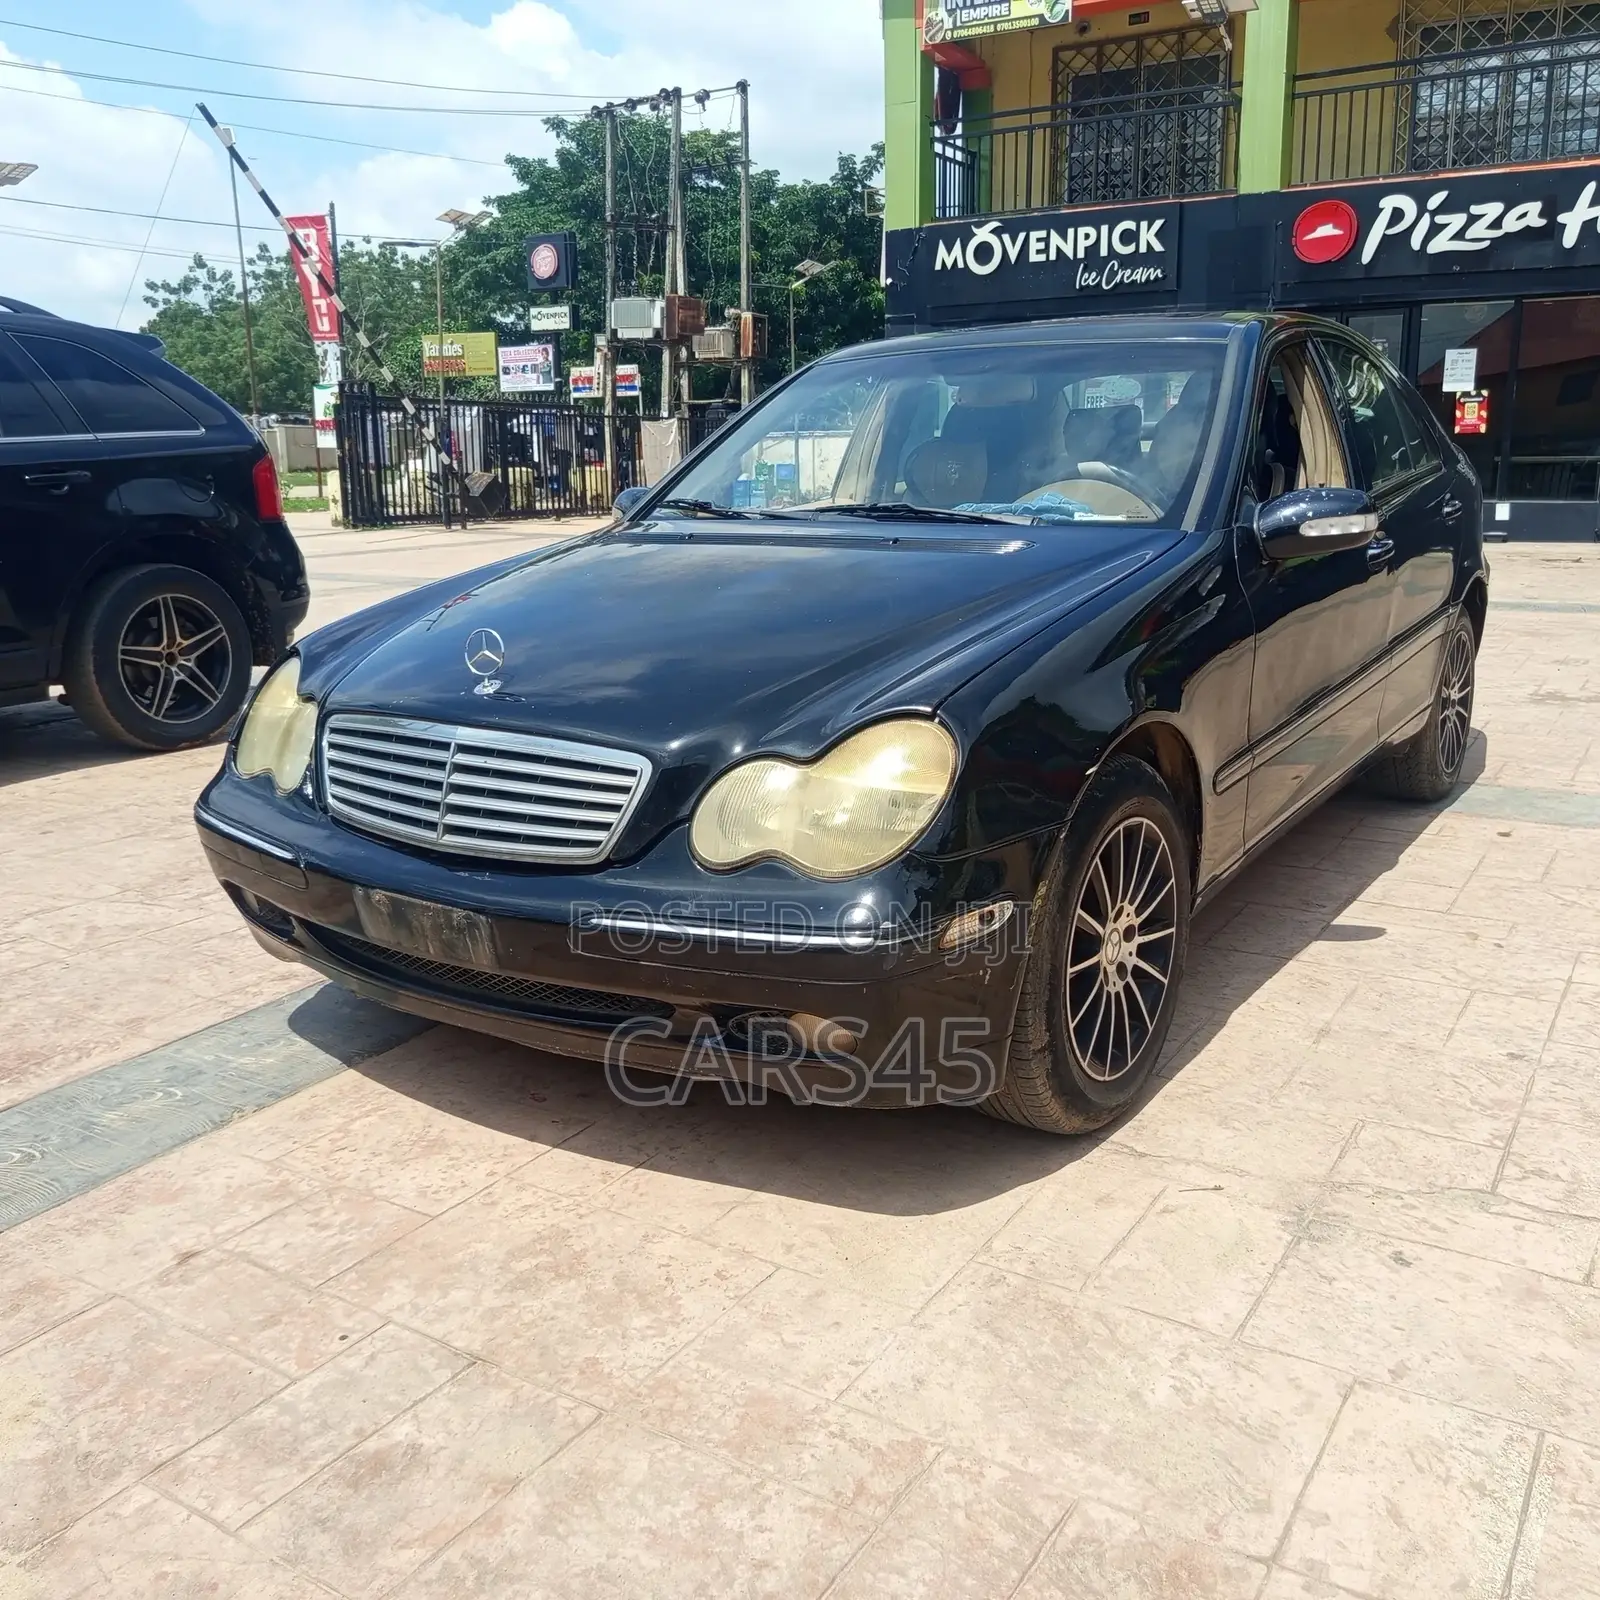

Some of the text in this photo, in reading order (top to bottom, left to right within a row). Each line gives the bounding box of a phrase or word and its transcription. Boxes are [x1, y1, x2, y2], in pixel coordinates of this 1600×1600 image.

[961, 3, 1010, 22] EMPIRE
[1361, 190, 1547, 265] Pizza
[1075, 260, 1164, 290] Ice Cream
